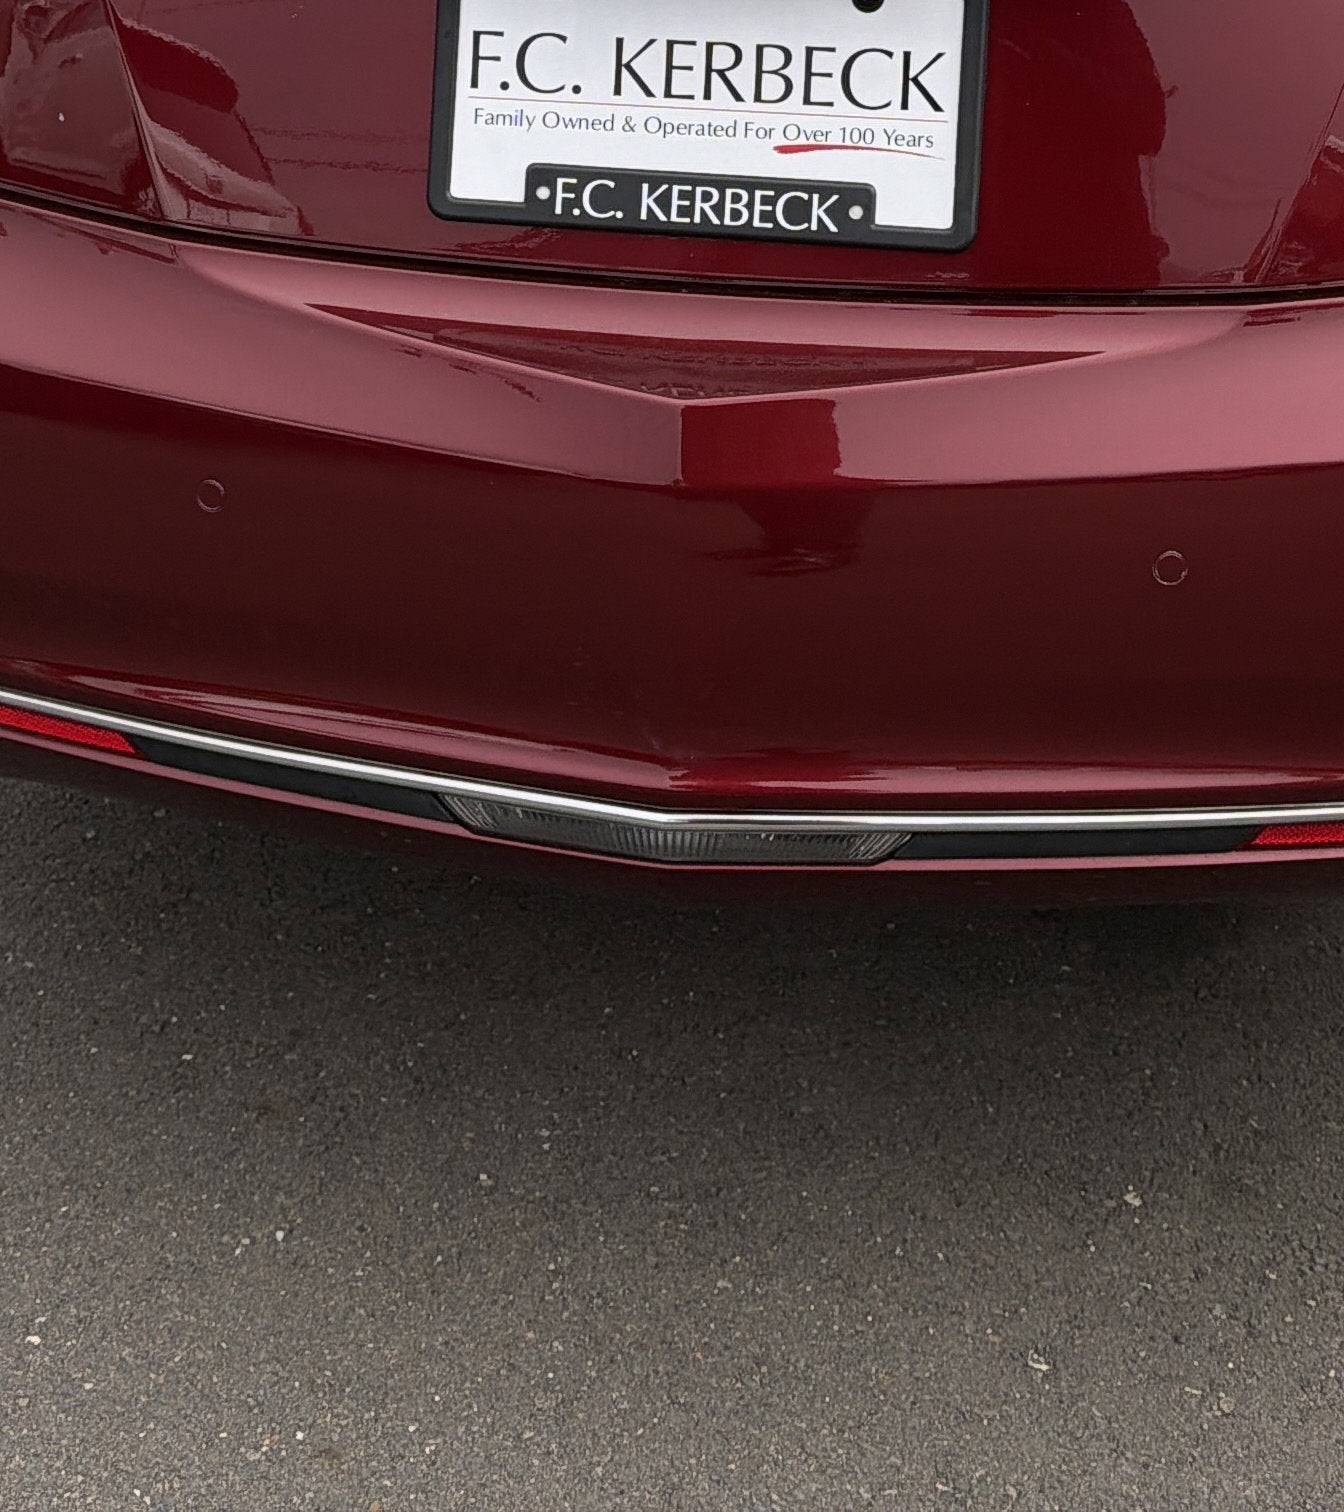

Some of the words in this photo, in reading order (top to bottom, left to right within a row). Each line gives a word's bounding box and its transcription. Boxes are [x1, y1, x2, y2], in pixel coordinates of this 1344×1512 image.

[469, 30, 582, 95] F.C.
[613, 37, 947, 113] KERBECK
[474, 107, 536, 133] Family
[542, 110, 615, 132] Owned
[621, 115, 638, 134] &
[644, 116, 737, 139] Operated
[744, 122, 776, 140] For
[783, 123, 832, 144] Over
[840, 126, 875, 145] 100
[883, 127, 935, 149] Years
[554, 177, 624, 219] F.C.
[640, 182, 841, 233] KERBECK
